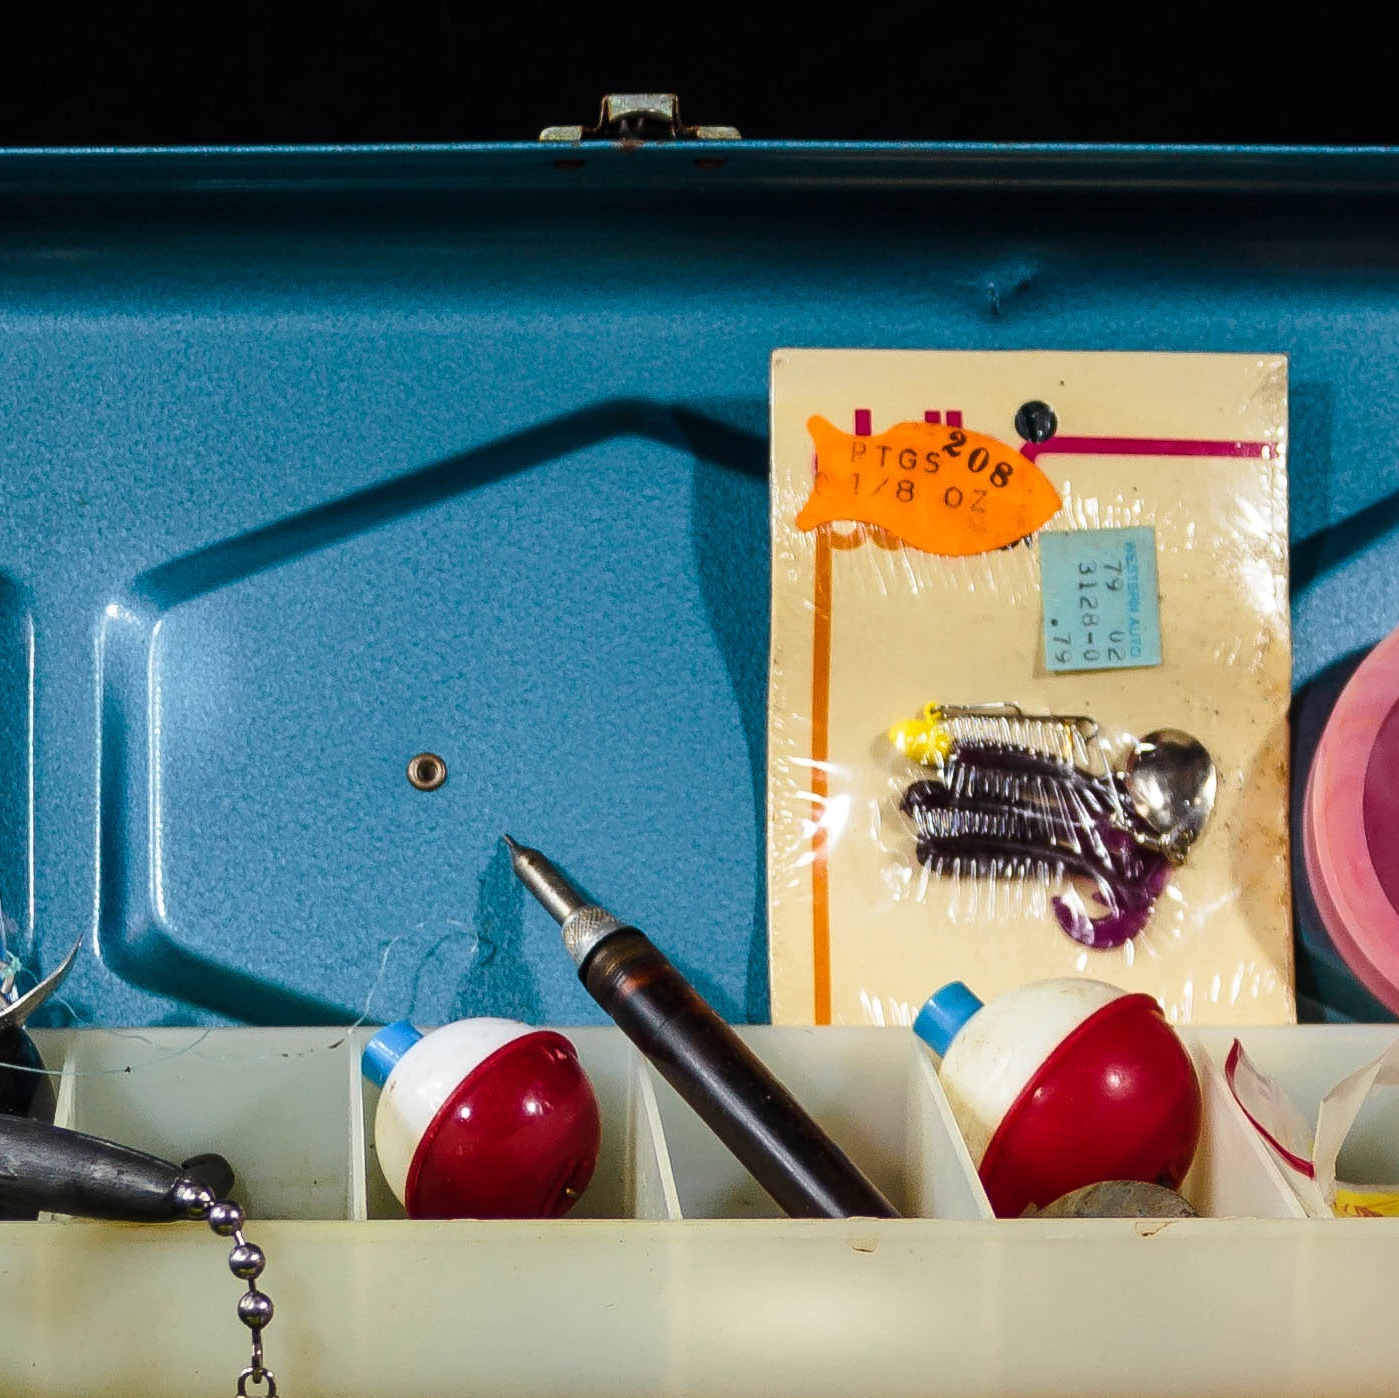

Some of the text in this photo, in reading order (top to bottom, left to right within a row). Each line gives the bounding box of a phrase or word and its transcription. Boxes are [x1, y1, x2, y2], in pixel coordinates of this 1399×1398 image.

[851, 441, 940, 474] PTGS
[942, 430, 1014, 488] 208
[853, 472, 915, 503] 1/8
